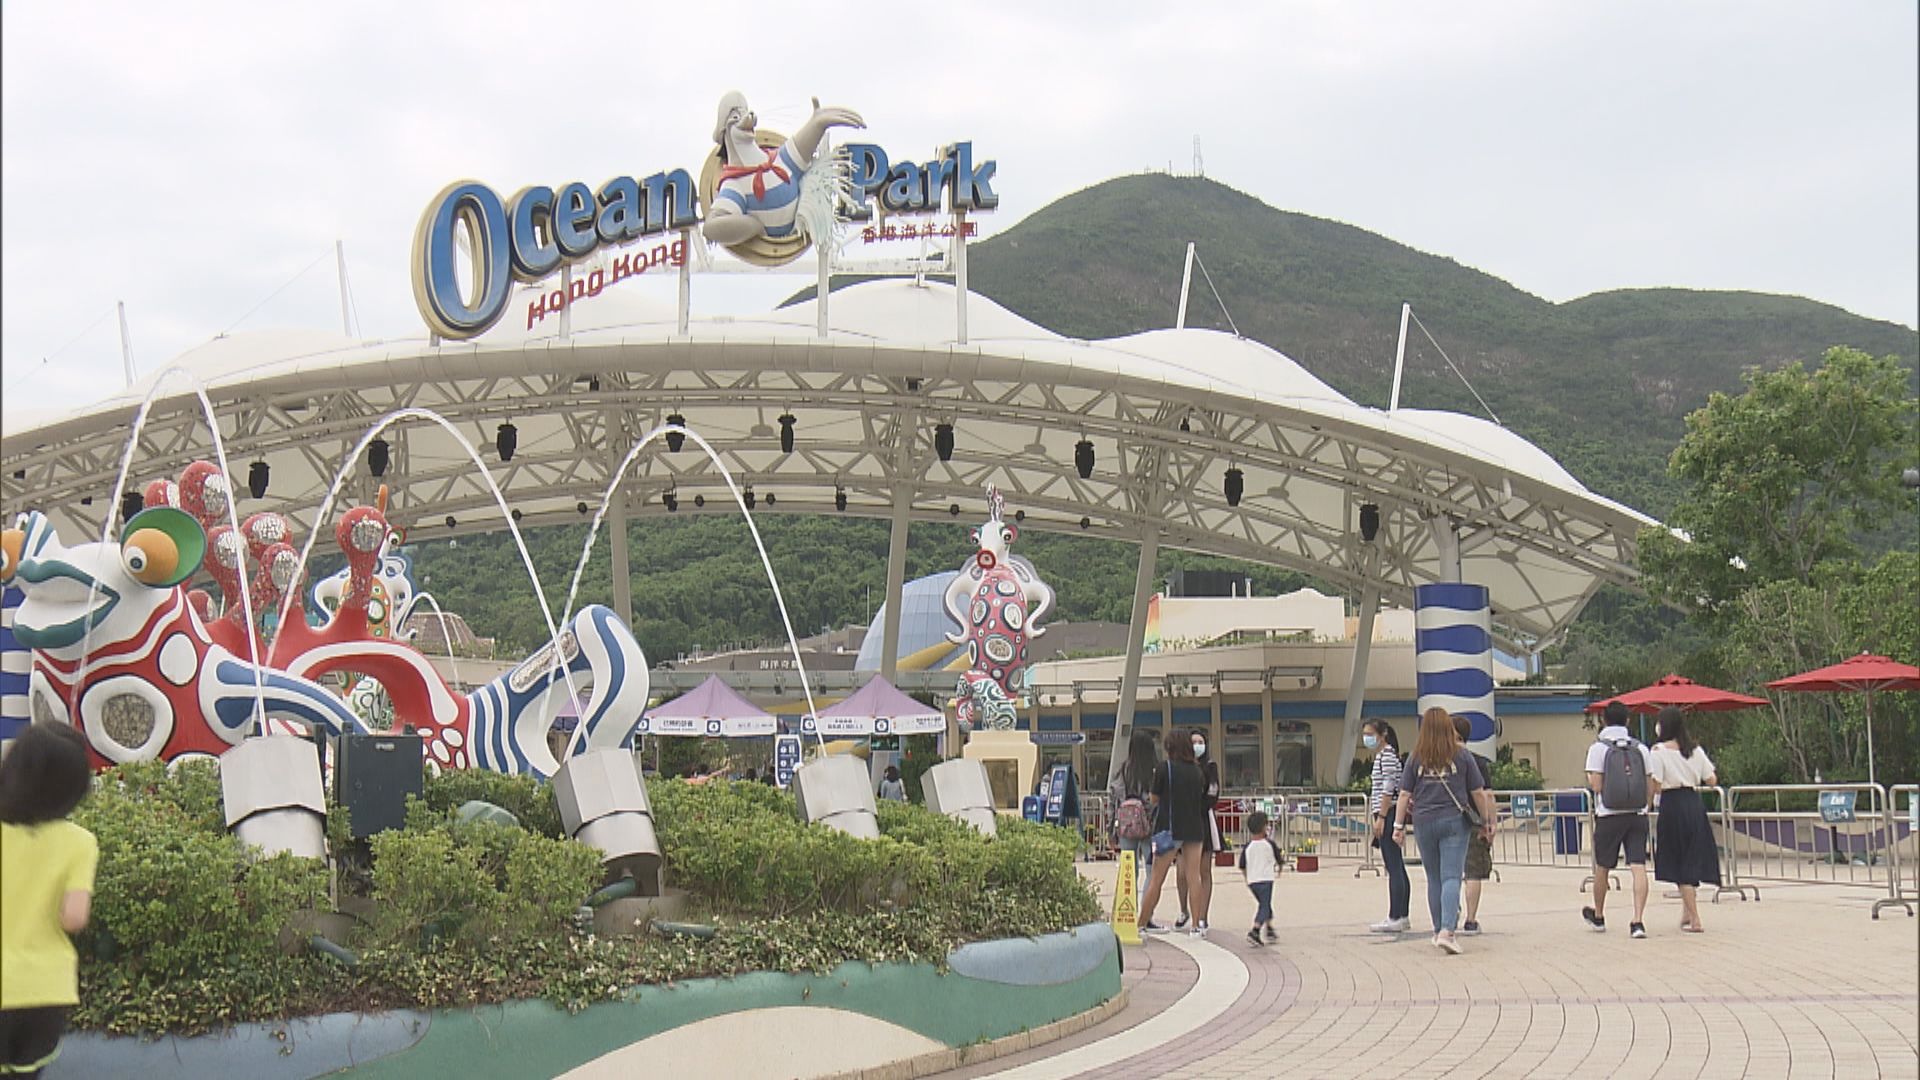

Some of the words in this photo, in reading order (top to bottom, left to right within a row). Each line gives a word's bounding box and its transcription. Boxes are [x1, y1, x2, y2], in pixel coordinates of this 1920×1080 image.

[411, 167, 698, 340] Ocean
[837, 140, 999, 220] Park
[861, 221, 978, 244] 香港海洋公園
[527, 269, 605, 331] Hong
[612, 239, 687, 283] Kong
[1830, 795, 1846, 805] Exit
